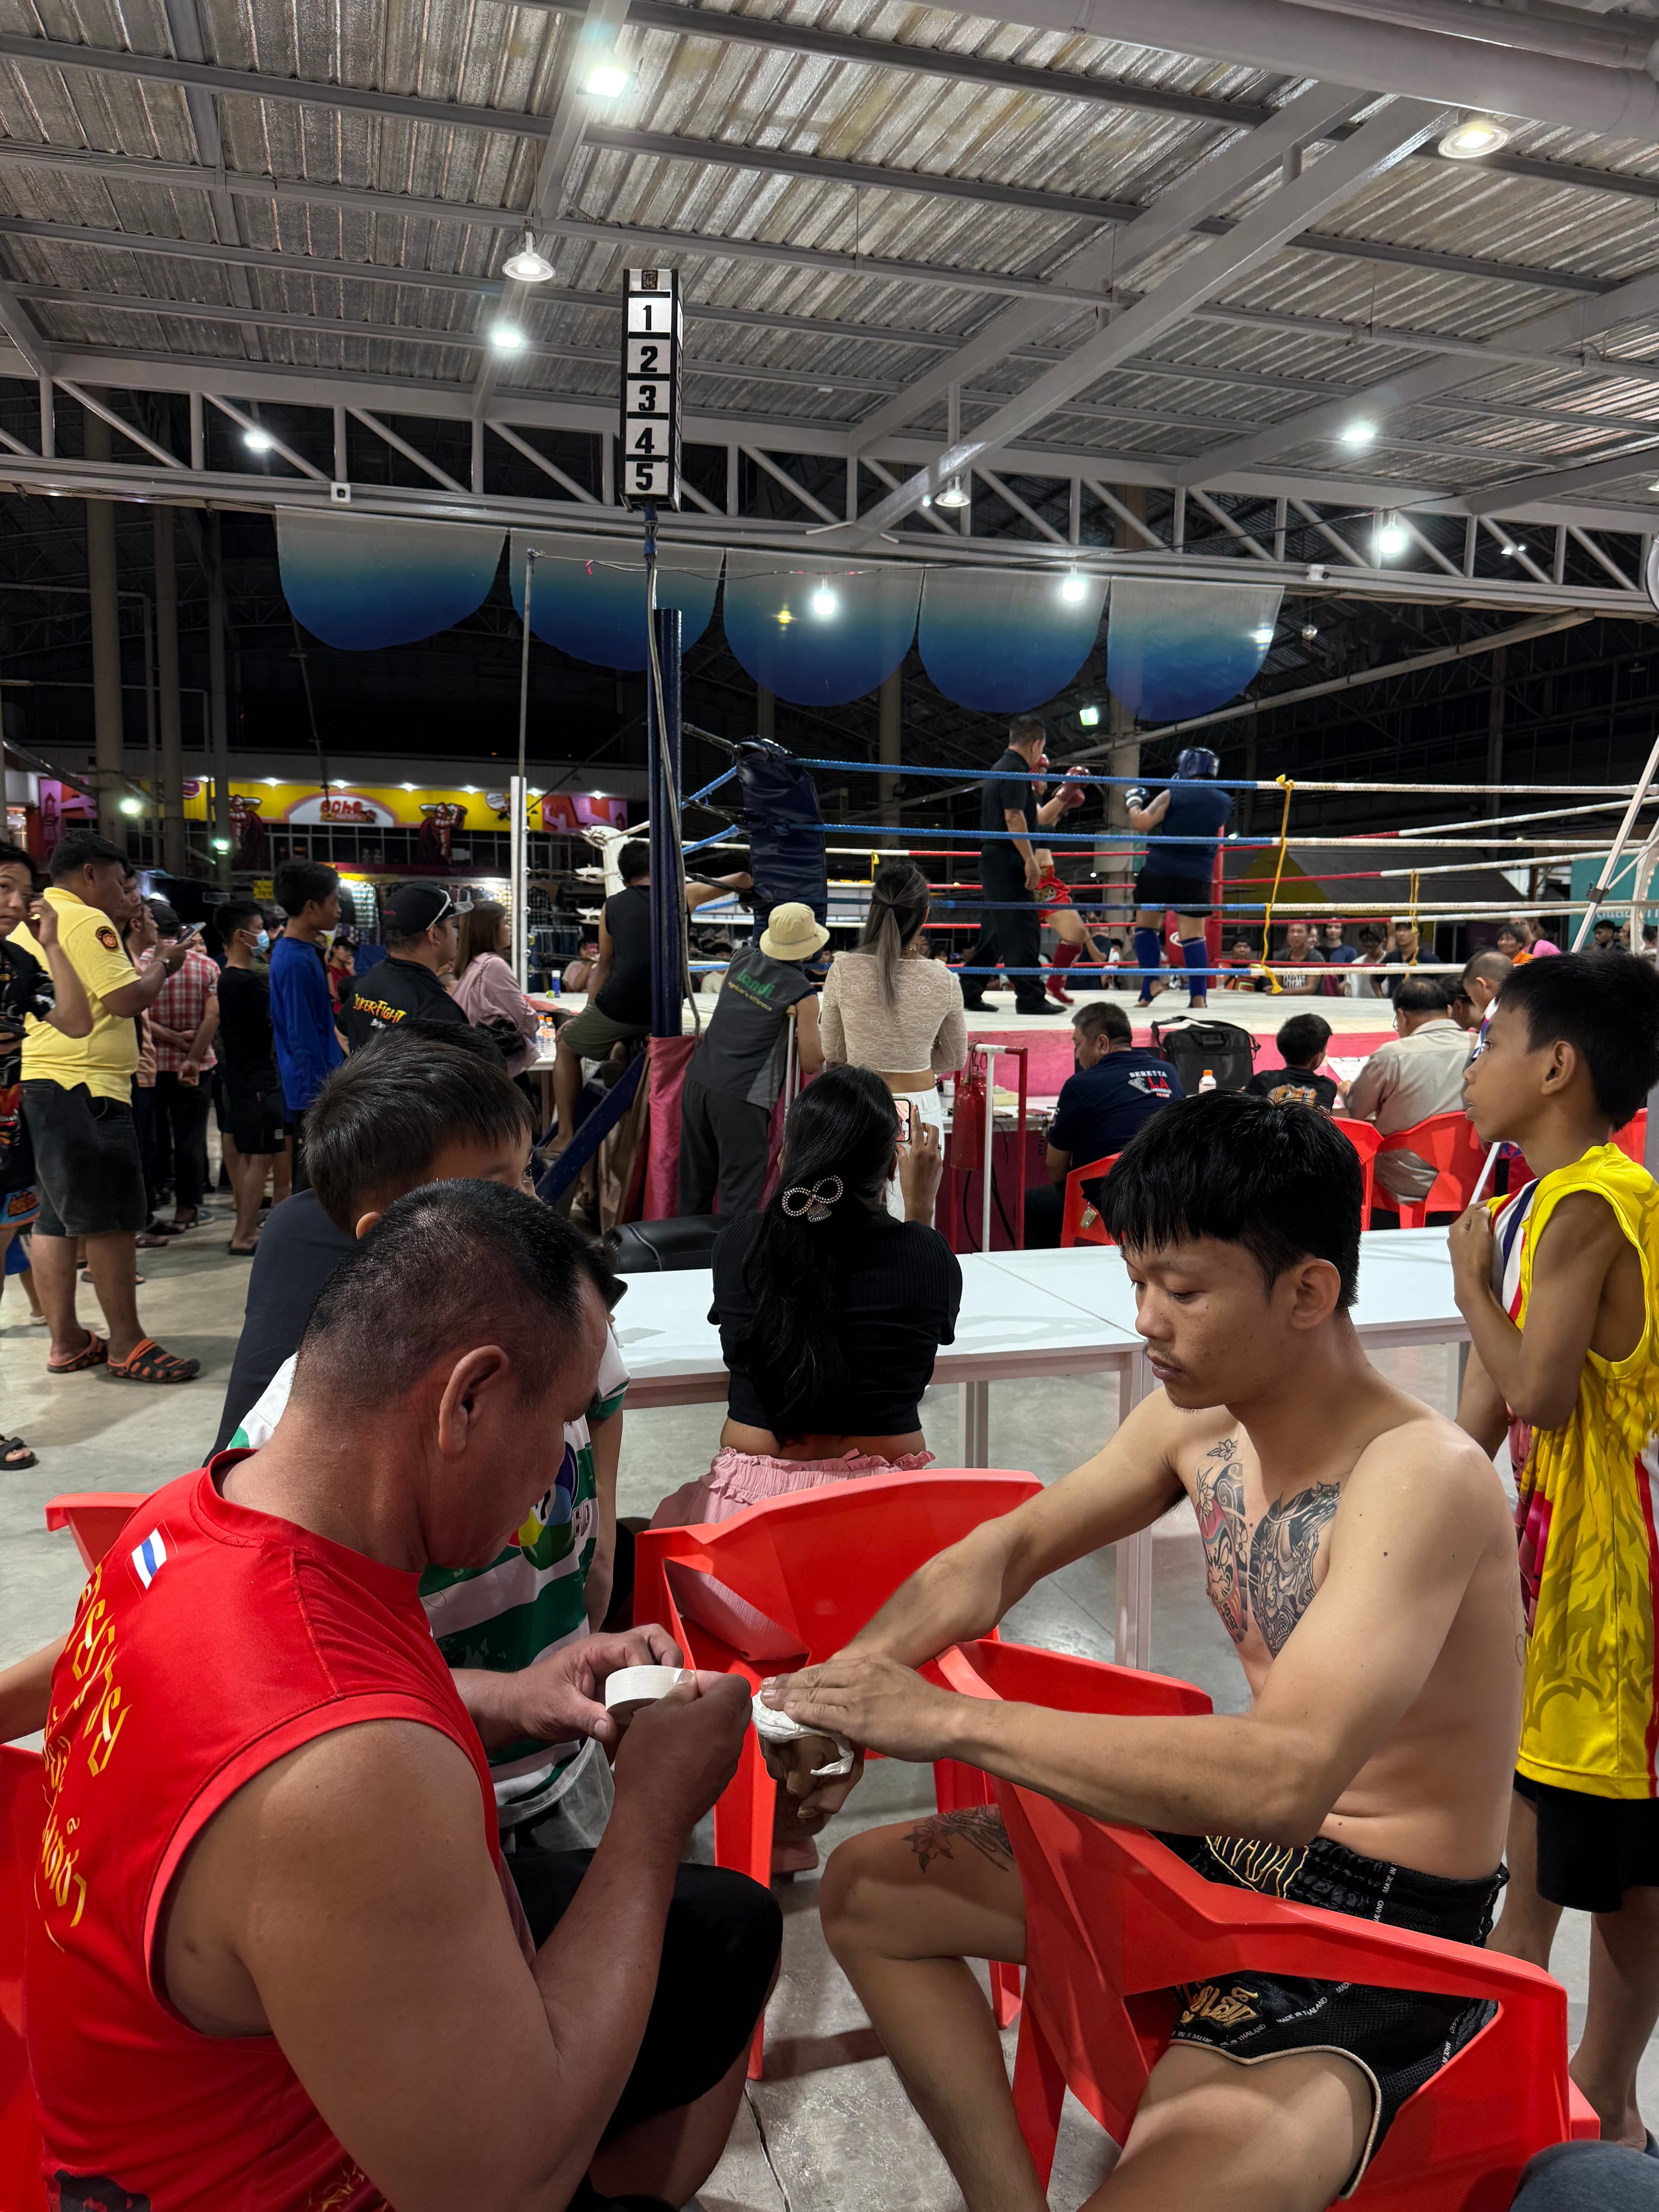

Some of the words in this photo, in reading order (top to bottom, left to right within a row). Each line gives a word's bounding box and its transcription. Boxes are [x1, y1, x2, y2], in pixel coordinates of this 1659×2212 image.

[643, 305, 652, 331] 1
[640, 346, 658, 372] 2
[639, 385, 656, 411] 3
[635, 427, 655, 454] 4
[636, 463, 653, 491] 5
[1147, 1076, 1169, 1089] LA
[572, 1497, 591, 1538] HD
[1382, 1875, 1394, 1894] MADE
[1389, 1867, 1397, 1875] IN
[1276, 2014, 1295, 2023] MADE
[1237, 2024, 1266, 2041] THAILAND
